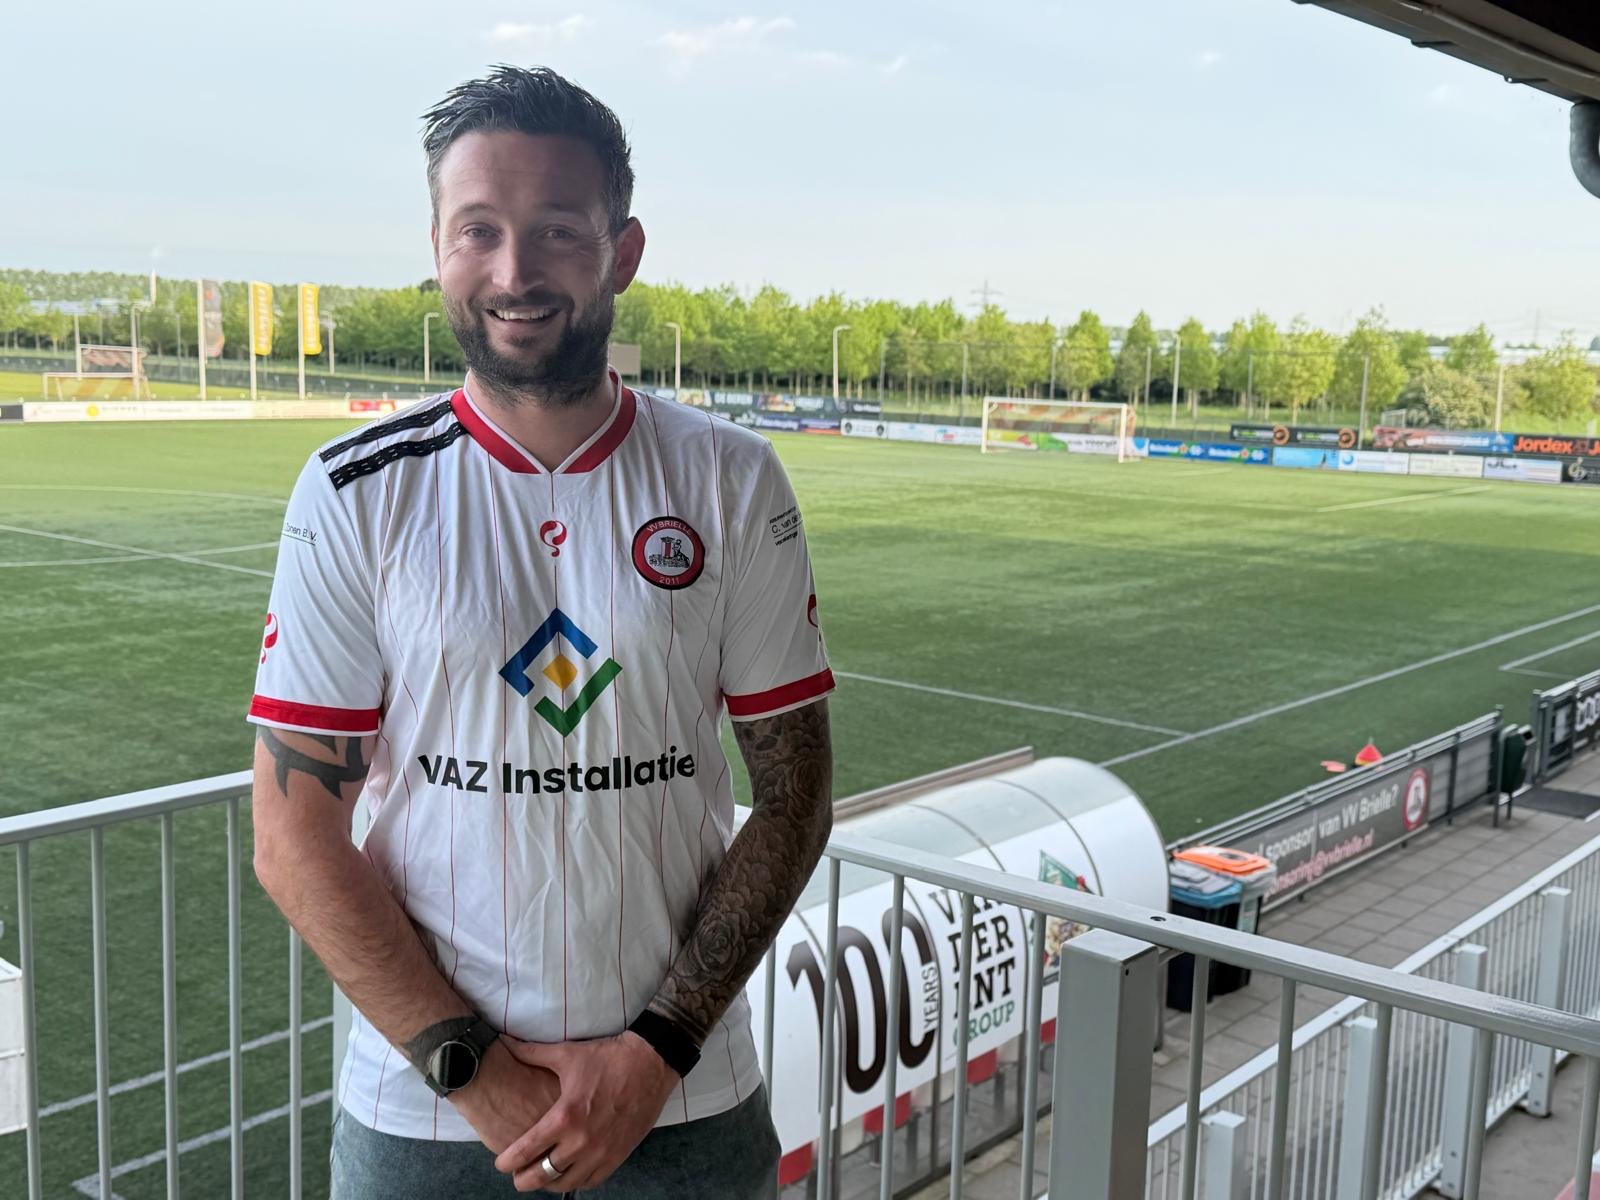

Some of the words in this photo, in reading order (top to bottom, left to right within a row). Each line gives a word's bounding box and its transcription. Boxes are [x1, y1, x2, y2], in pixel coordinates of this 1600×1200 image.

[1513, 437, 1572, 453] Jordex
[302, 528, 317, 541] B.V.
[659, 576, 680, 585] 2011
[418, 754, 488, 793] VAZ
[502, 745, 695, 794] Installatie
[1265, 825, 1316, 863] sponsor
[1319, 814, 1341, 838] van
[1359, 784, 1399, 820] Brielle?
[786, 907, 935, 1113] 100
[922, 965, 939, 1031] YEARS
